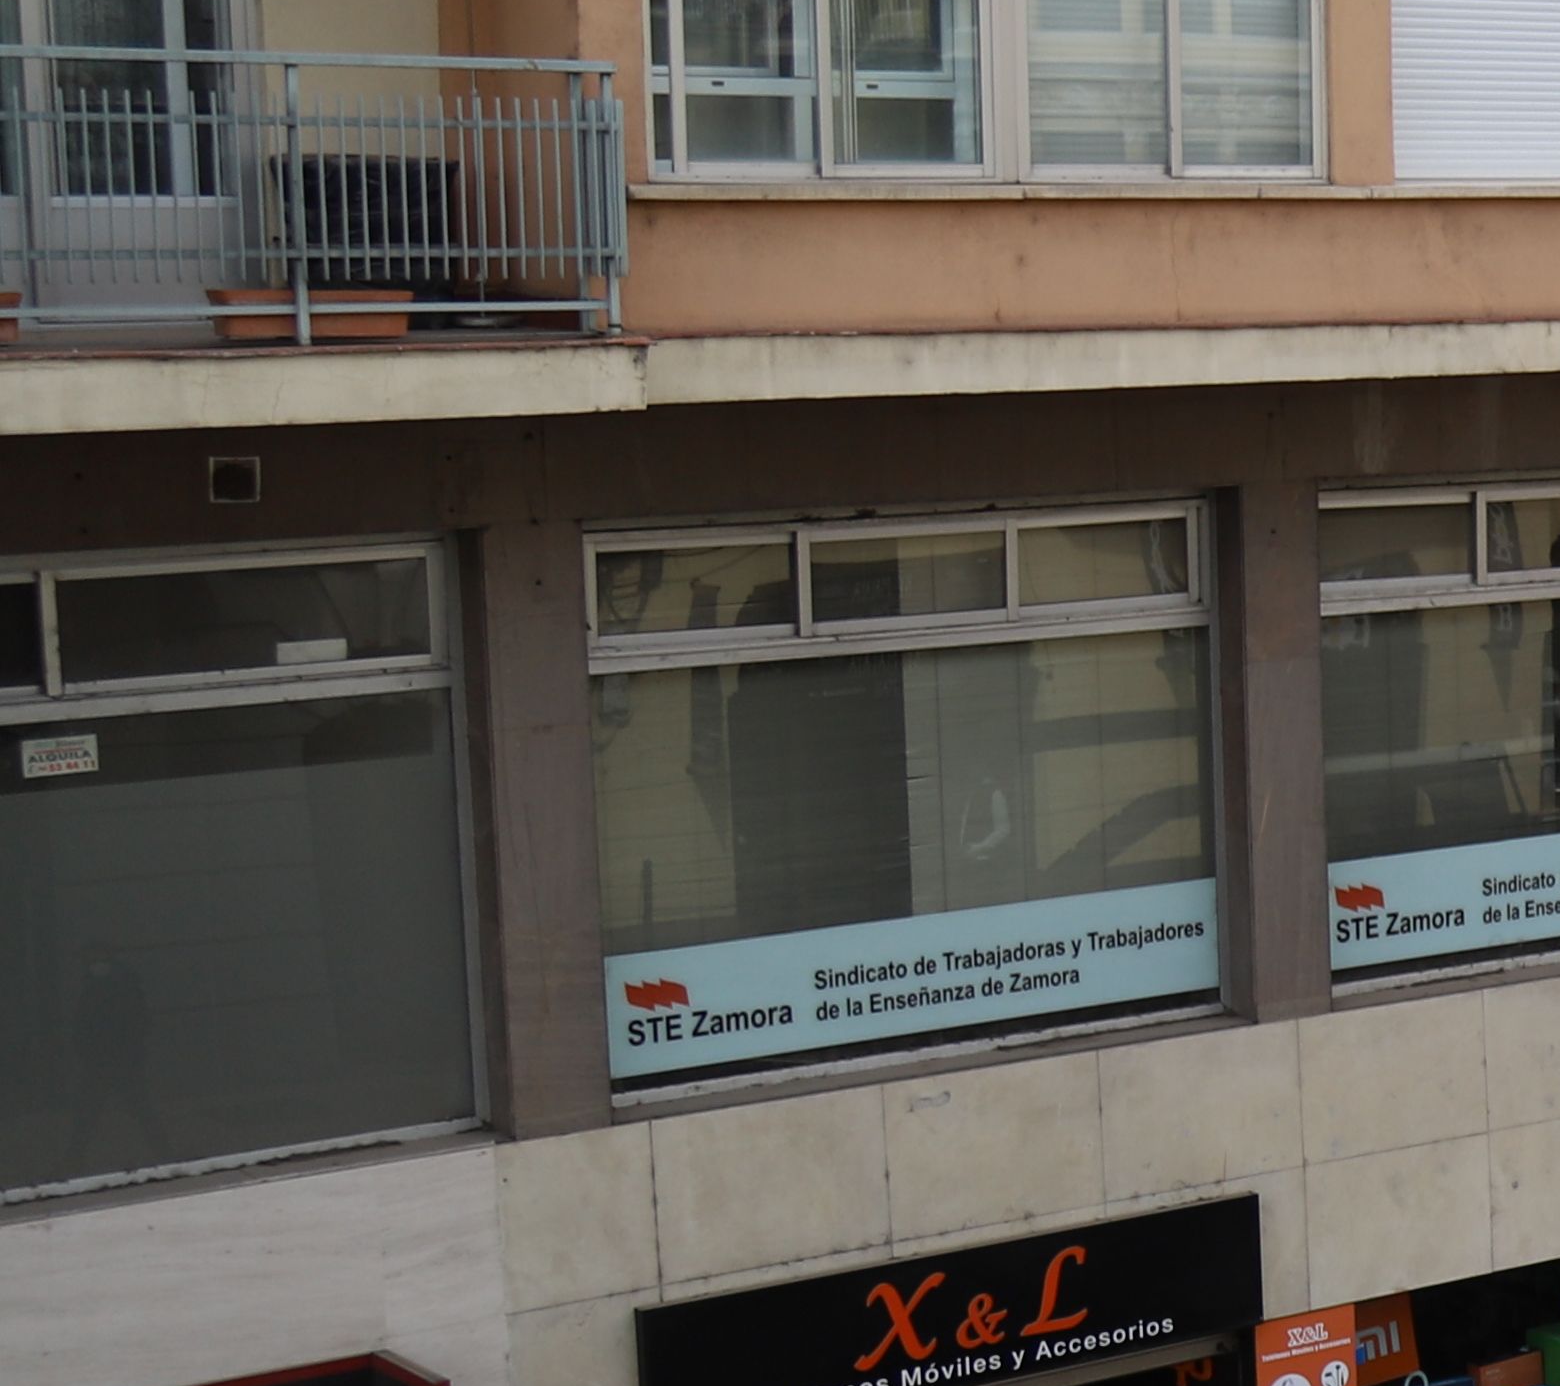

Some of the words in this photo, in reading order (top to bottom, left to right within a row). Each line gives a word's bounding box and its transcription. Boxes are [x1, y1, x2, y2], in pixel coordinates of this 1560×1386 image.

[1482, 871, 1555, 897] Sindicato
[1336, 915, 1379, 942] STE
[1386, 905, 1466, 936] Zamora
[1483, 905, 1502, 924] de
[1506, 902, 1520, 922] la
[814, 962, 907, 991] Sindicato
[914, 956, 937, 976] de
[943, 940, 1065, 972] Trabajadoras
[1071, 938, 1082, 959] y
[1088, 921, 1204, 952] Trabajadores
[816, 1001, 840, 1021] de
[847, 997, 863, 1017] la
[870, 984, 975, 1014] Enseñanza
[982, 976, 1004, 998] de
[1010, 967, 1080, 993] Zamora
[628, 1014, 683, 1047] STE
[692, 1004, 793, 1038] Zamora
[853, 1272, 946, 1371] X
[955, 1292, 1008, 1349] &
[1019, 1246, 1089, 1338] L
[1012, 1348, 1025, 1371] y
[1035, 1317, 1175, 1361] Accesorios
